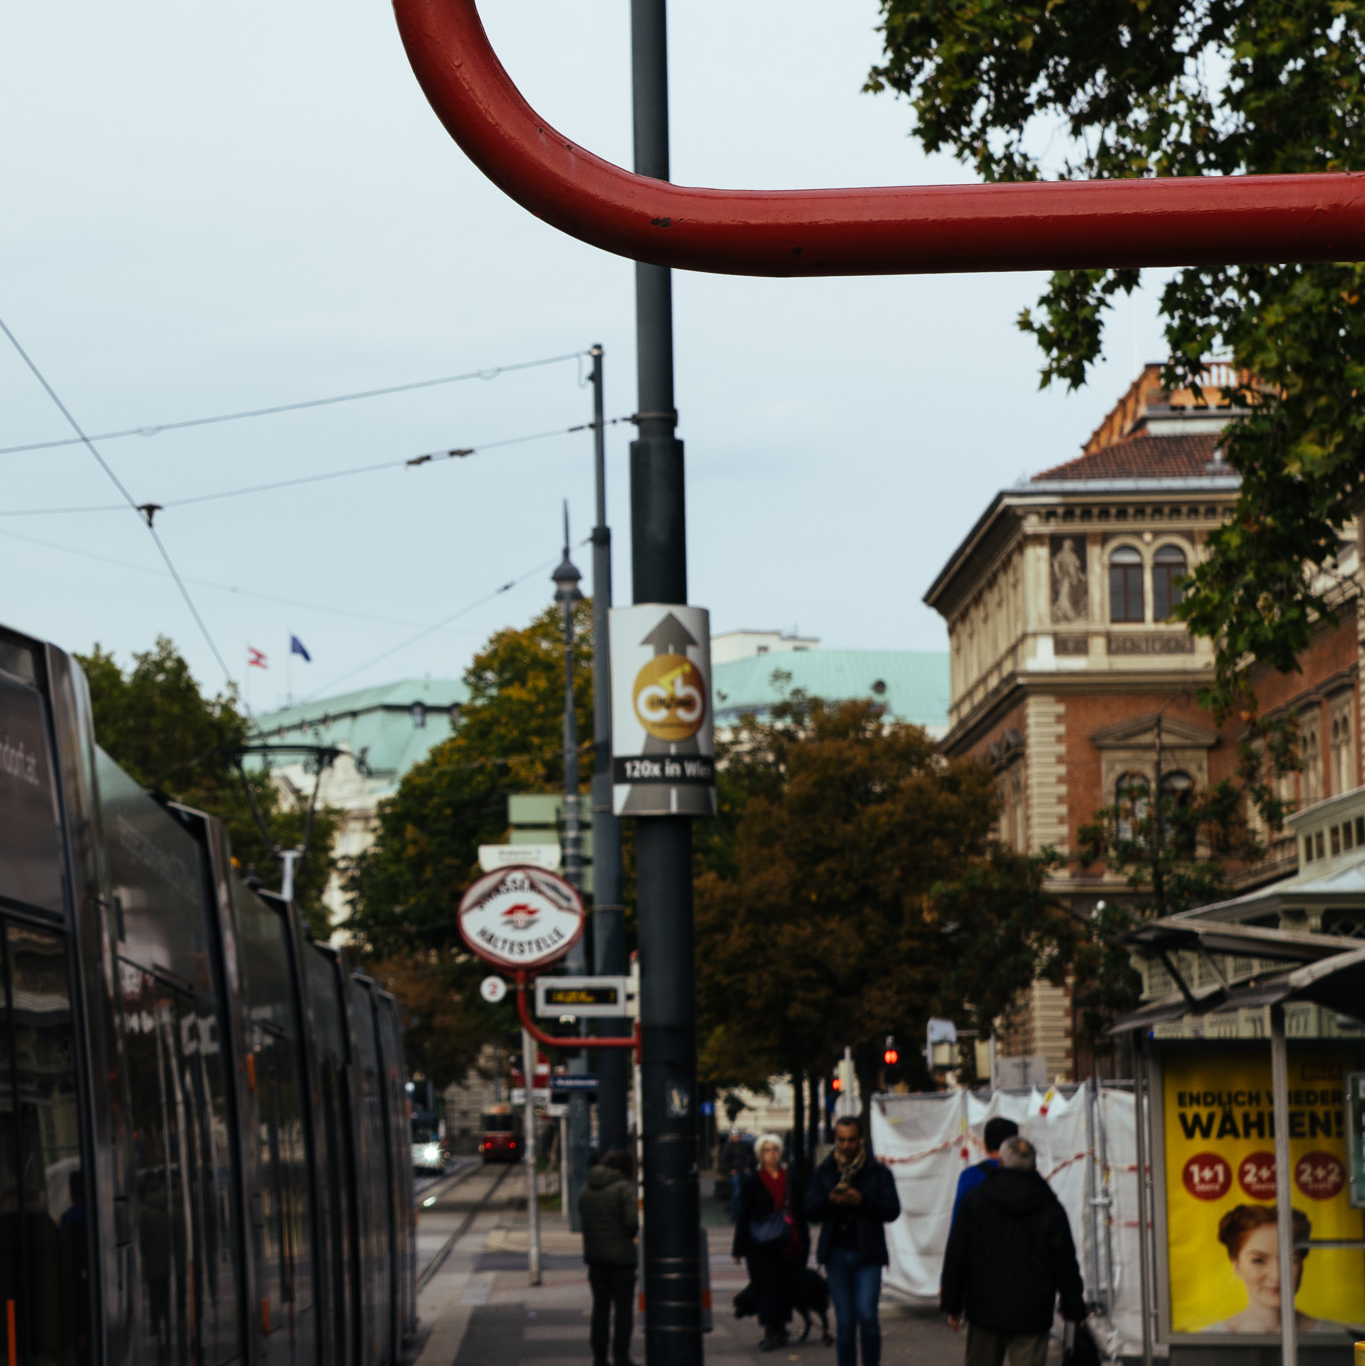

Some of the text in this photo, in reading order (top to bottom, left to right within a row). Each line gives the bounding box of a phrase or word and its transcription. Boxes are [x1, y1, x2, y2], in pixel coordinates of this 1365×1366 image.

[624, 759, 662, 779] 120x
[665, 758, 682, 778] in
[1177, 1090, 1261, 1107] ENDLICH
[1189, 1163, 1225, 1185] 1+1
[1298, 1162, 1341, 1185] 2+2
